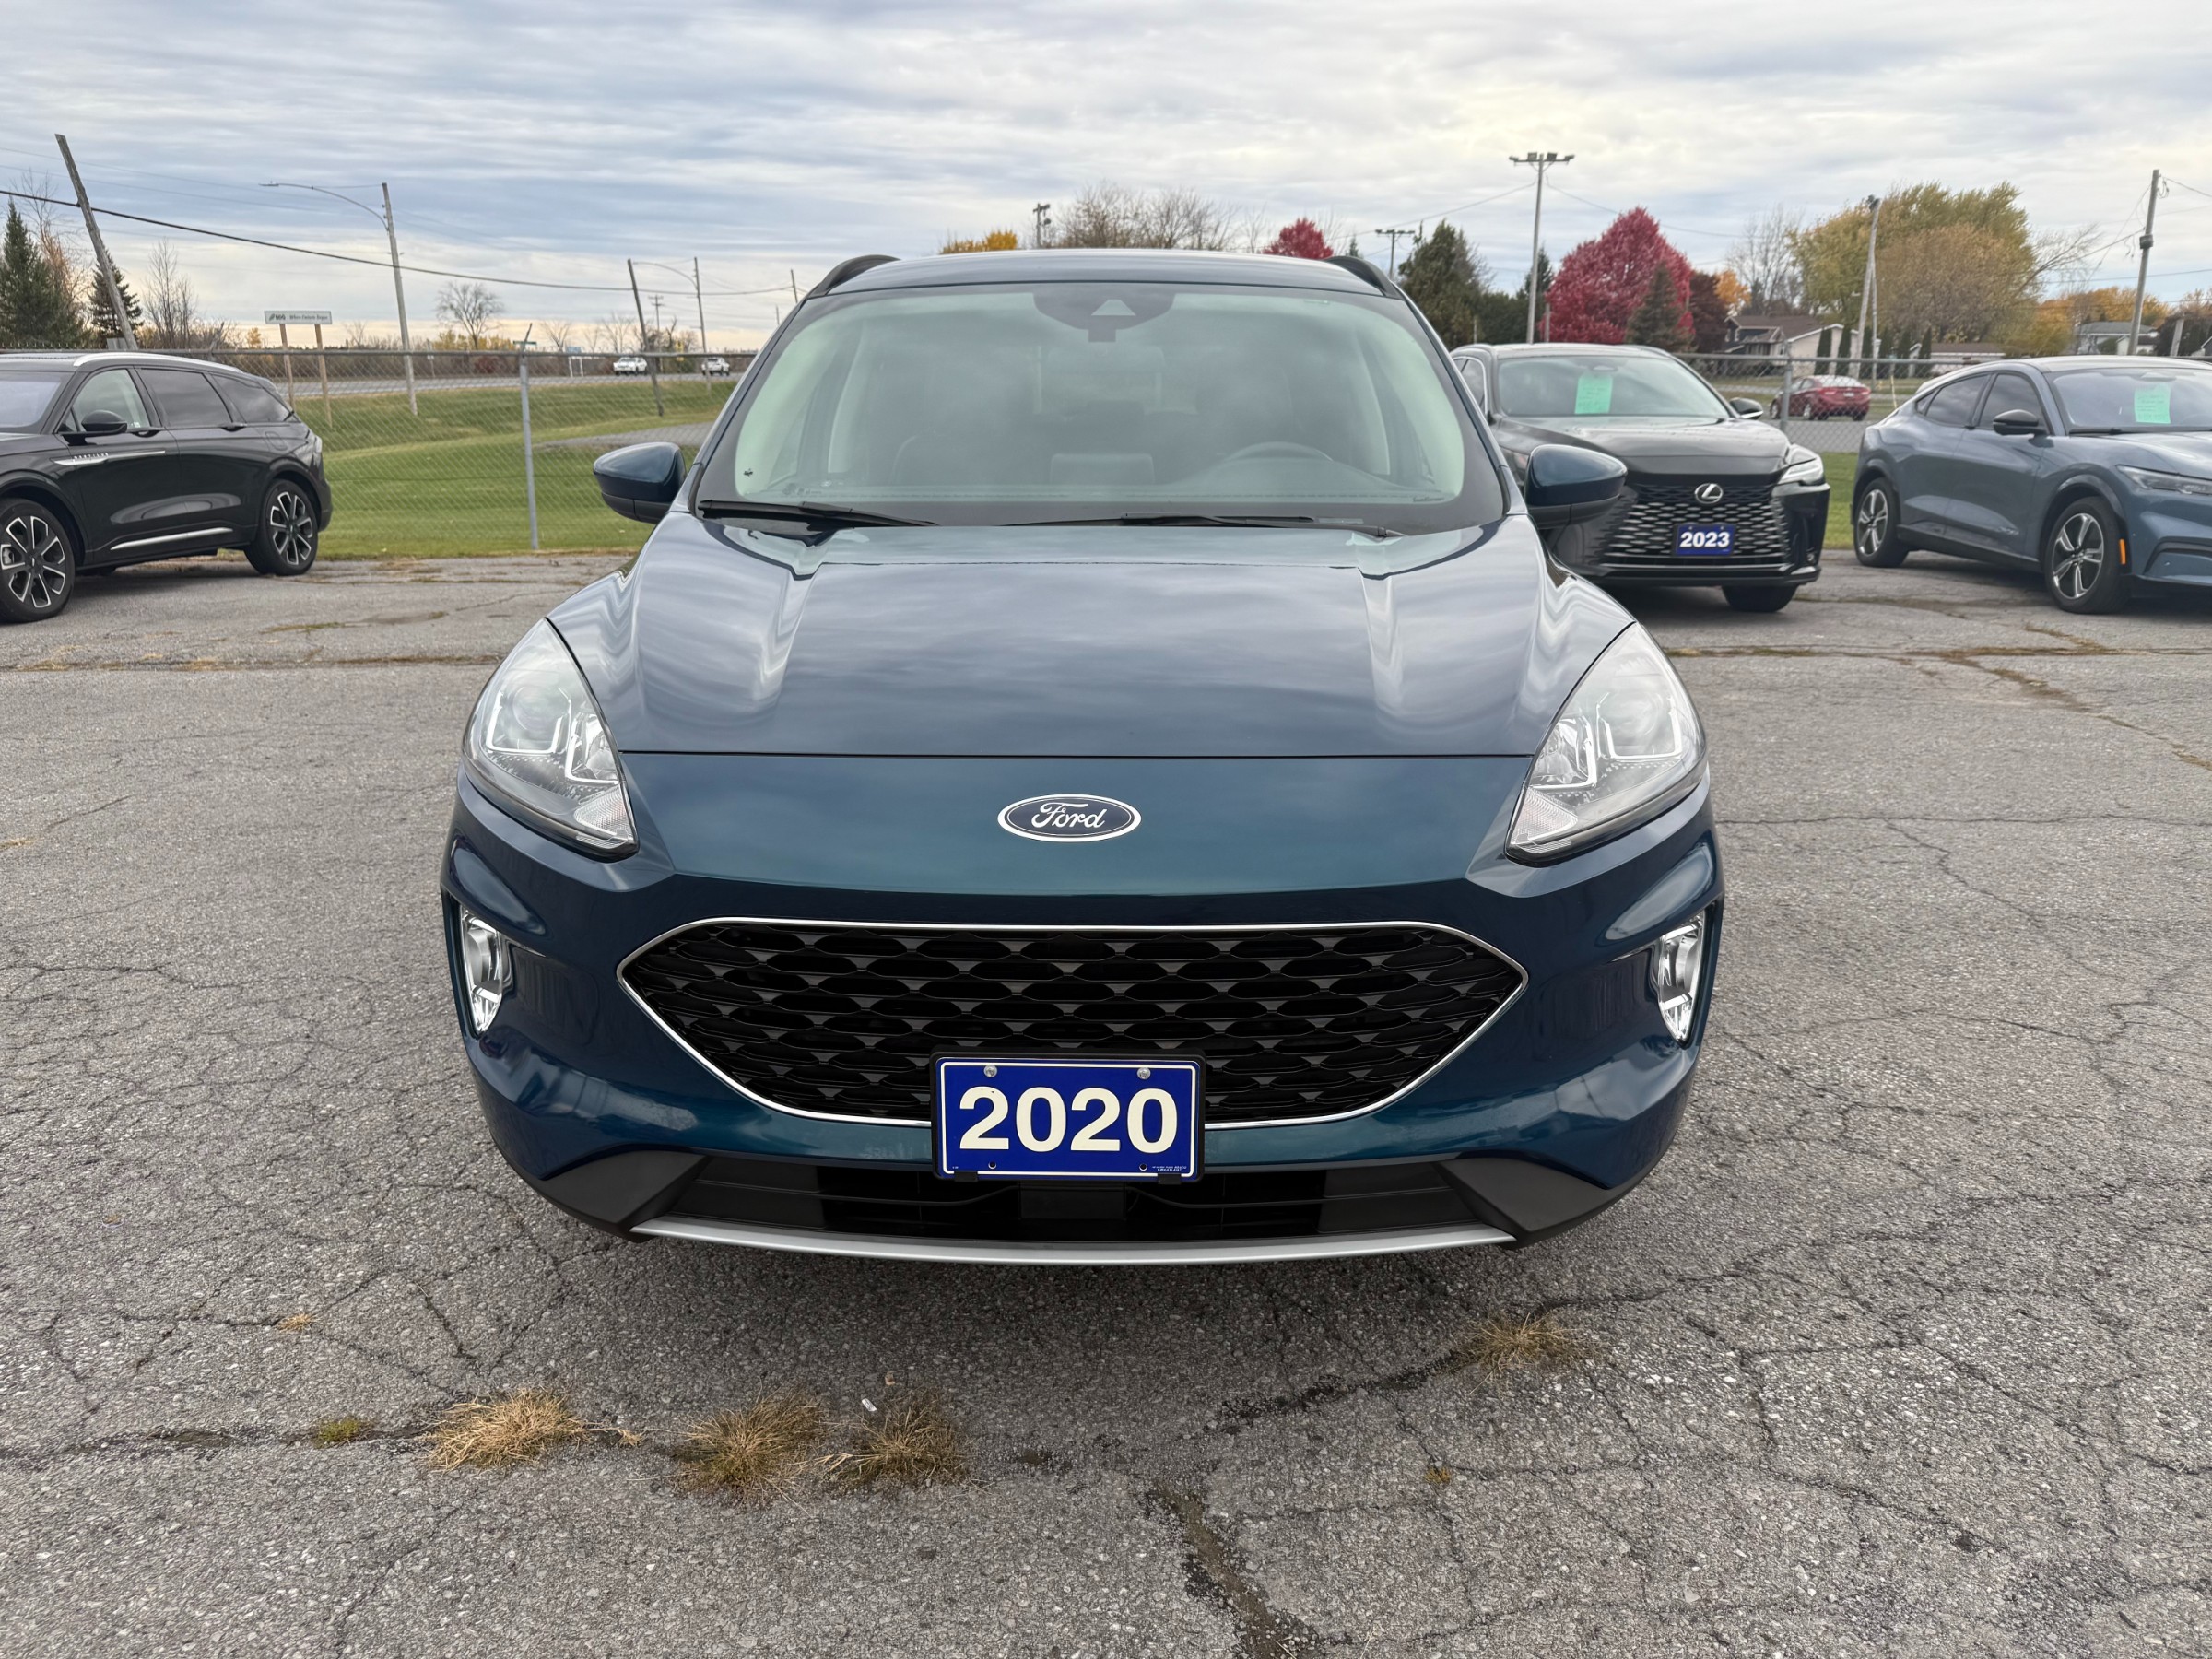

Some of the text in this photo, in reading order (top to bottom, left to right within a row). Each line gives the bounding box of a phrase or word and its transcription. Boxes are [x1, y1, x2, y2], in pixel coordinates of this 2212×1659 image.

[1679, 531, 1730, 548] 2023
[1031, 802, 1108, 828] Ford
[959, 1086, 1178, 1153] 2020
